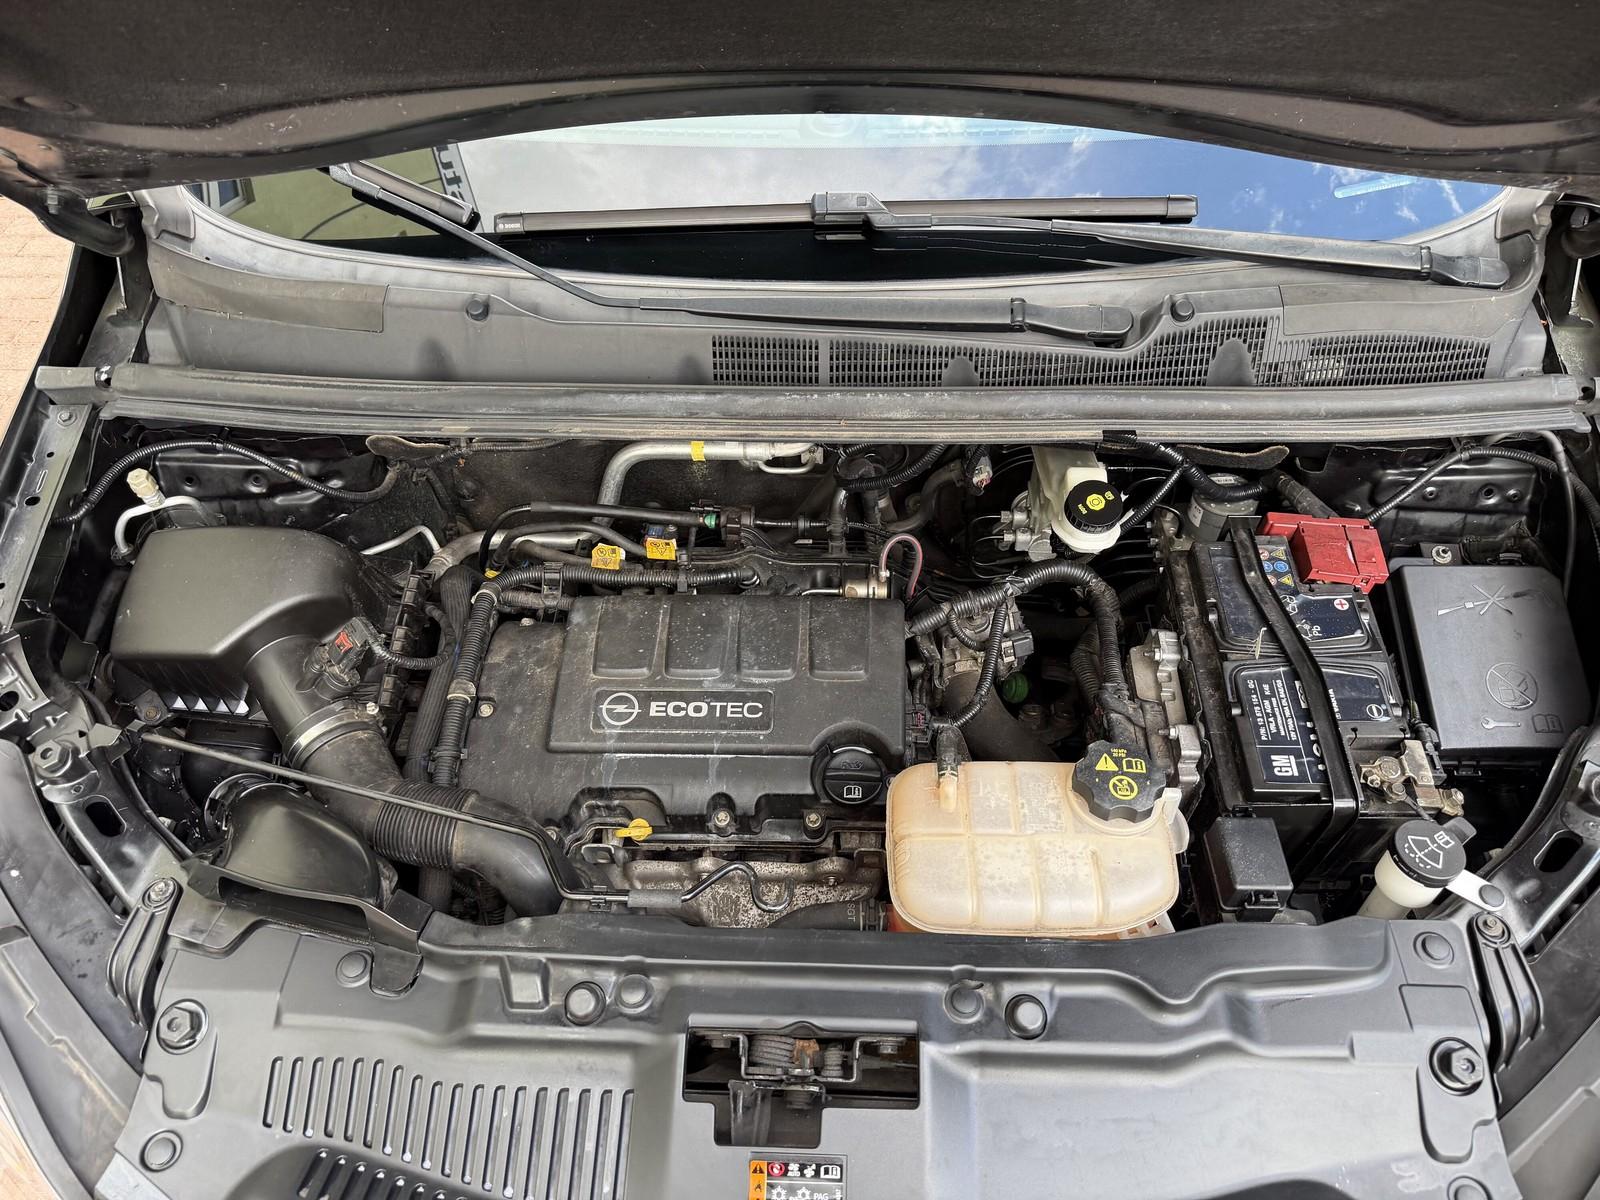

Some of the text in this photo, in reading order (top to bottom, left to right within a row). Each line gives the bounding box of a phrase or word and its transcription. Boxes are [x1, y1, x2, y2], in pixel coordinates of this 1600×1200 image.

[1311, 625, 1323, 636] Pb
[649, 701, 764, 719] ECOTEC
[1262, 699, 1273, 714] AGM
[1270, 754, 1294, 777] GM
